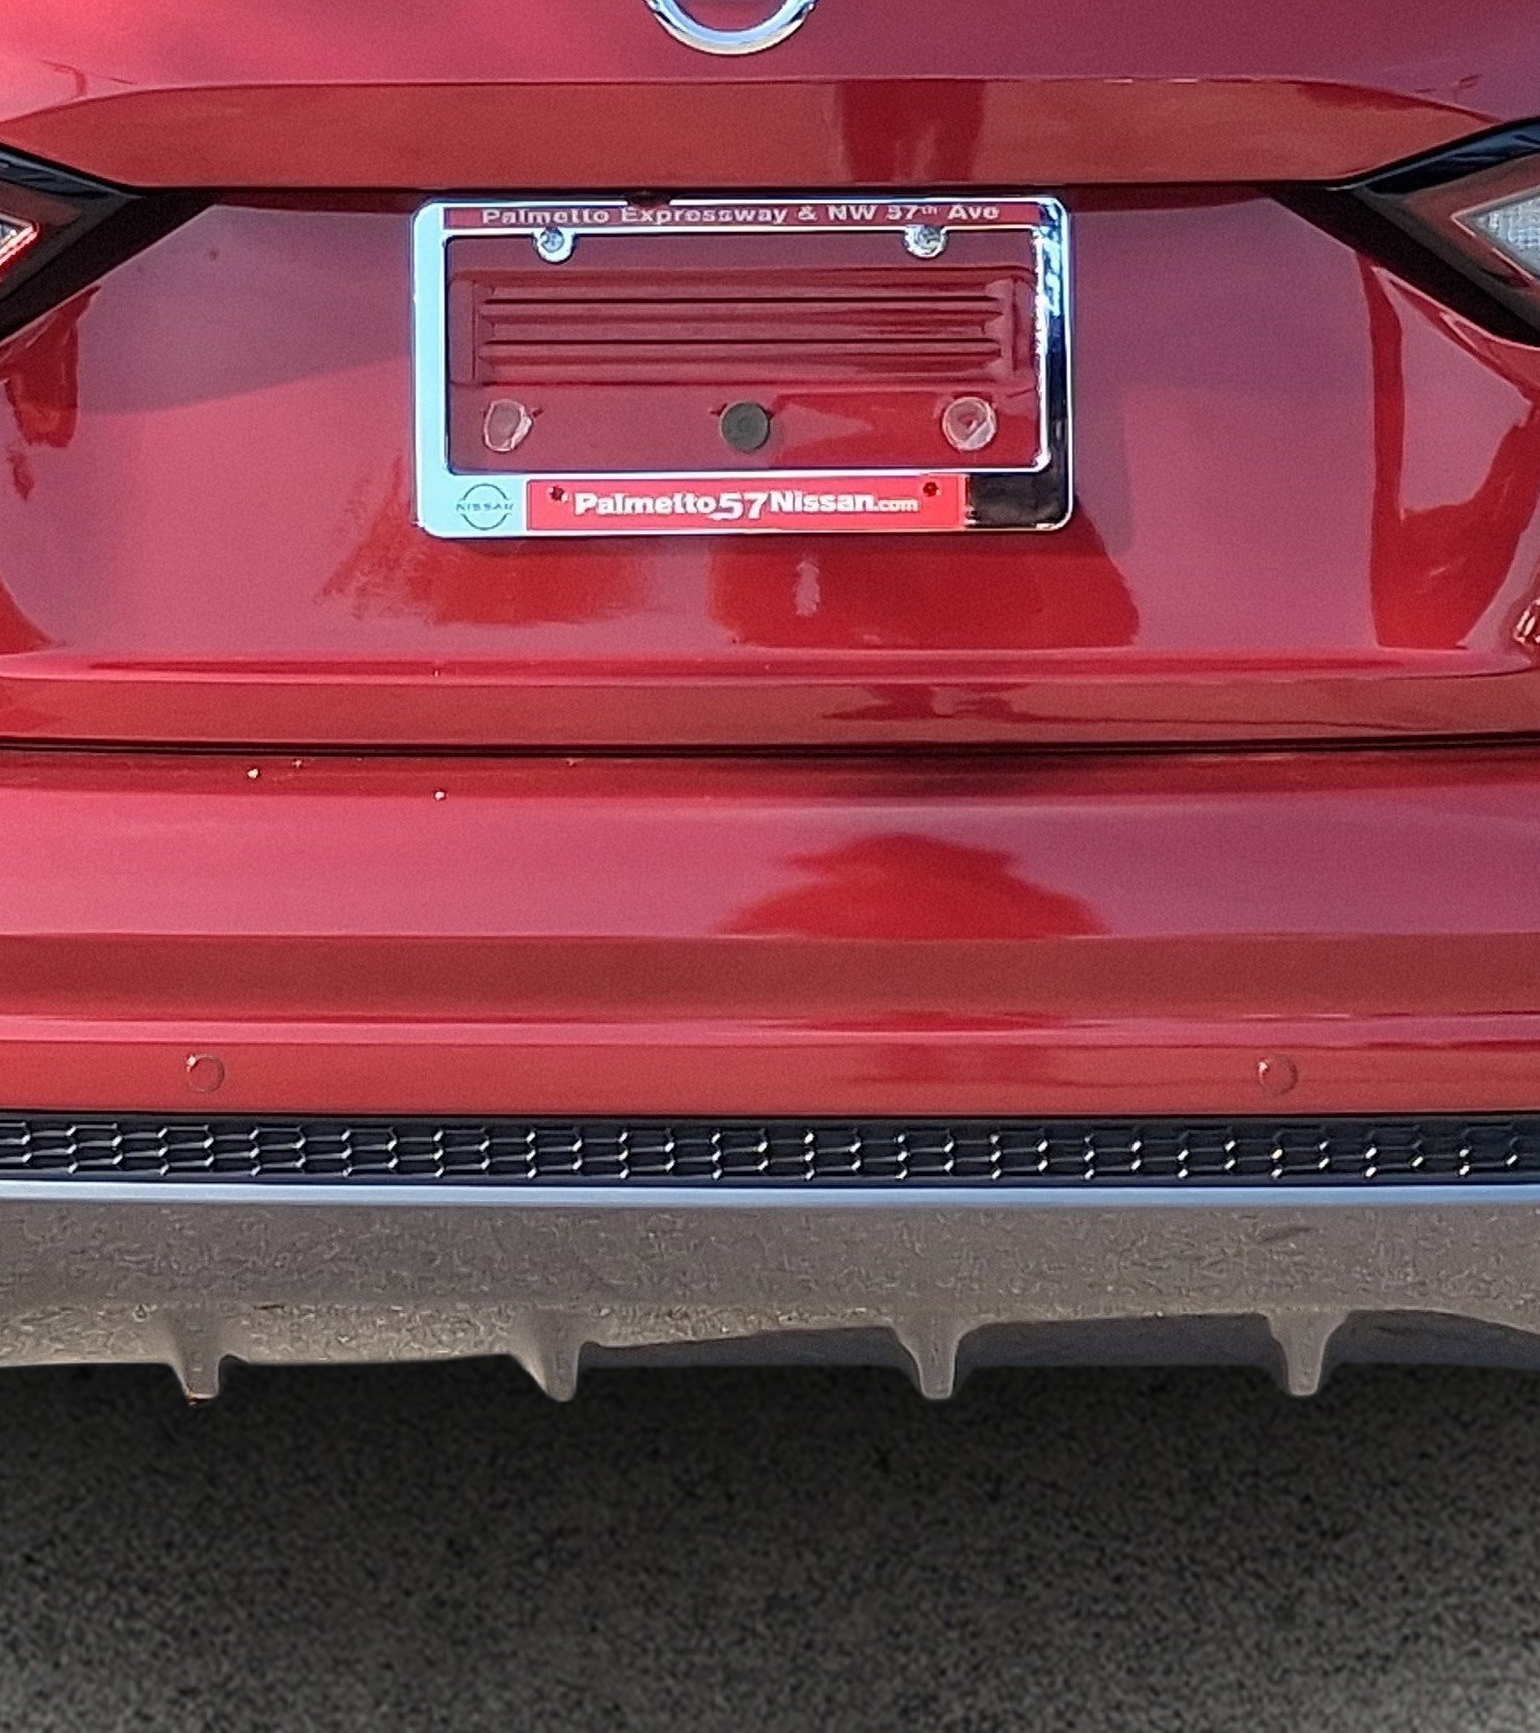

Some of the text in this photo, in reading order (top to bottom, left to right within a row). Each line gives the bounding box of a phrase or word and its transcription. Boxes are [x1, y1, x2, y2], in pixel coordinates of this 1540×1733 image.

[482, 208, 609, 225] Palmetto
[621, 206, 788, 226] Expressway
[796, 206, 818, 222] &
[827, 205, 878, 221] NW
[947, 204, 1000, 220] Ave
[574, 490, 920, 520] Palmetto57Nissan.com
